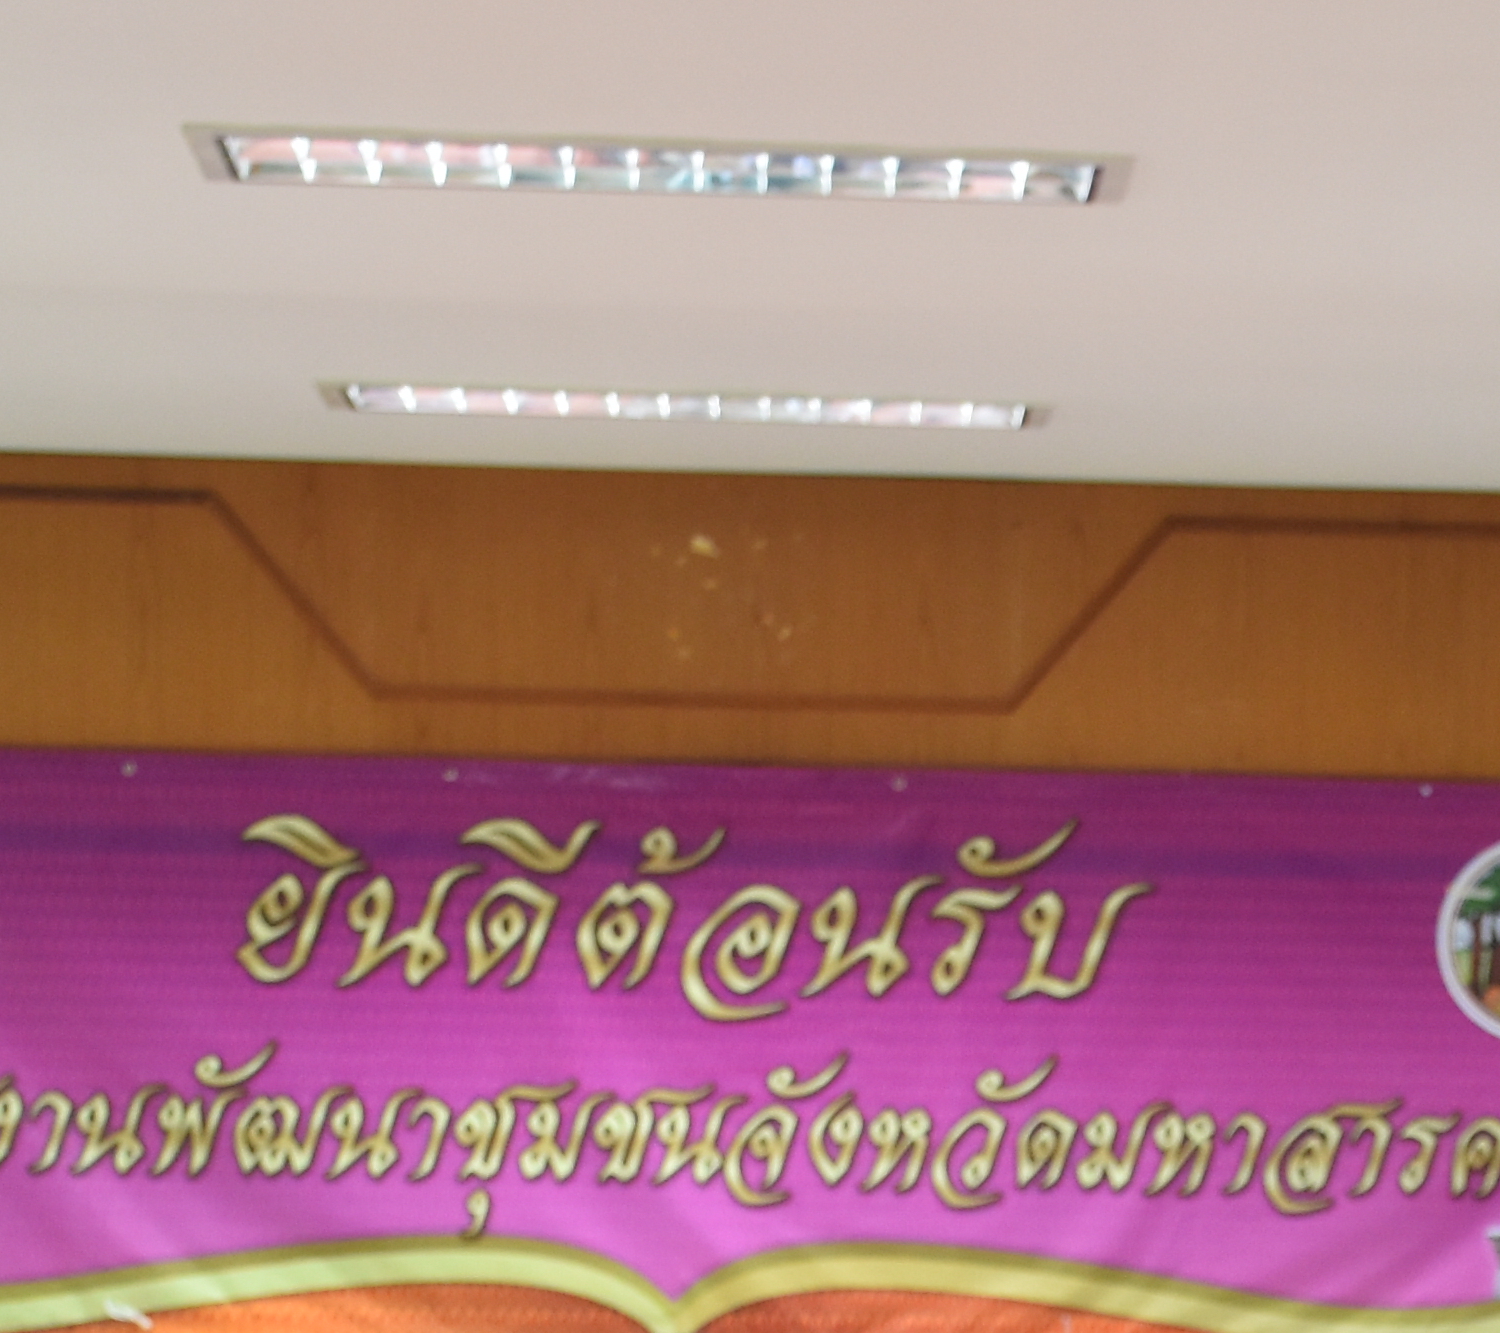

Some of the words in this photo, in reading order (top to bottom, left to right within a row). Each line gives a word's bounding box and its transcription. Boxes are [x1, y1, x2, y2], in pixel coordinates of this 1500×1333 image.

[237, 813, 1155, 1022] ยินดีต้อนรับ
